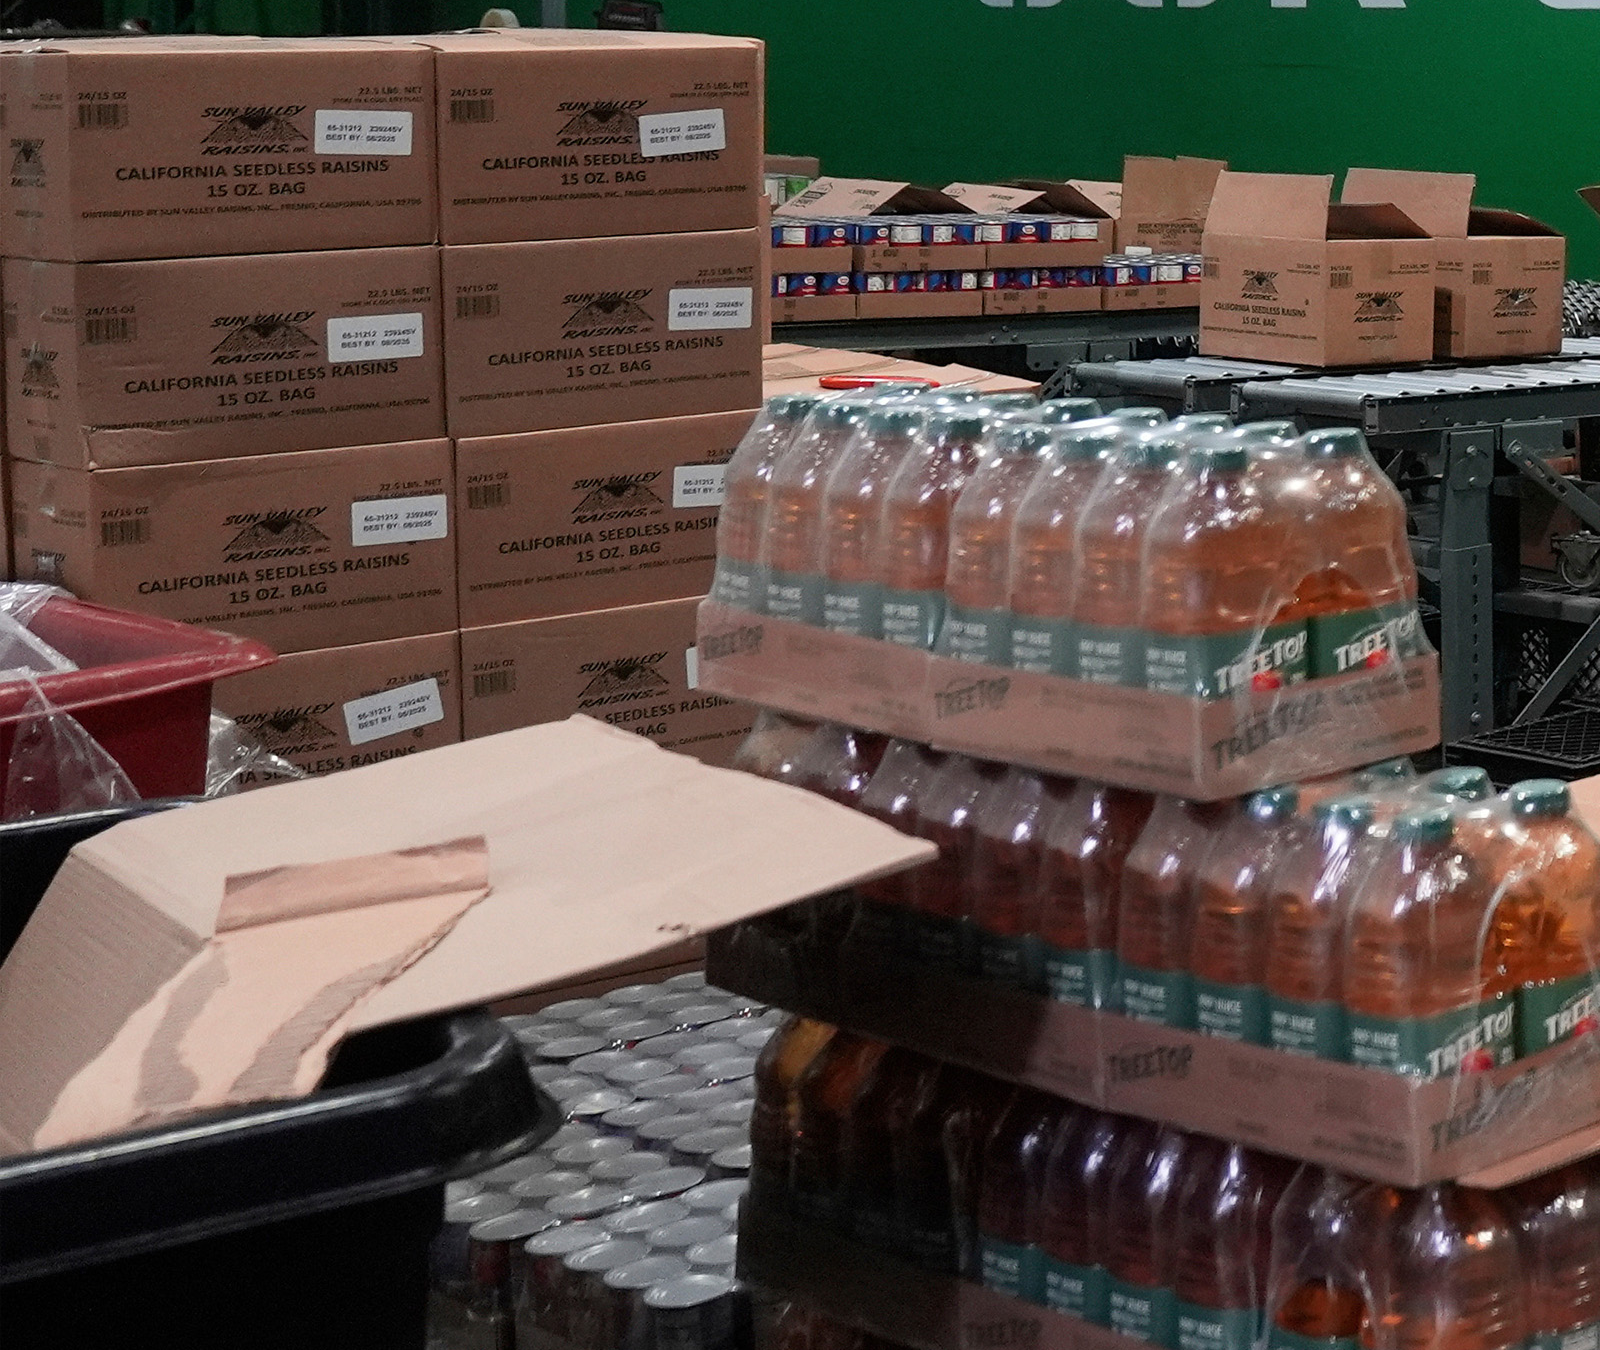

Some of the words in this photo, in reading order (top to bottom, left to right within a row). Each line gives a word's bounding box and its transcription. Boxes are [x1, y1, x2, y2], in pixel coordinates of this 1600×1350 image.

[201, 106, 239, 118] SUN
[243, 105, 307, 118] VALLEY
[555, 101, 590, 112] SUN
[593, 99, 649, 111] VALLEY
[325, 133, 348, 142] BEST
[650, 135, 669, 144] BEST
[115, 164, 228, 181] CALIFORNIA
[233, 162, 317, 178] SEEDLESS
[321, 159, 390, 174] RAISINS
[482, 154, 579, 171] CALIFORNIA
[583, 151, 656, 167] SEEDLESS
[560, 173, 579, 186] 15
[583, 171, 609, 185] OZ.
[615, 170, 647, 183] BAG
[207, 184, 228, 198] 15
[233, 182, 262, 197] OZ.
[269, 182, 306, 196] BAG
[560, 292, 596, 305] SUN
[599, 288, 653, 301] VALLEY
[1212, 301, 1250, 314] CALIFORNIA
[1251, 305, 1281, 316] SEEDLESS
[1281, 306, 1307, 318] RAISINS
[210, 315, 250, 328] SUN
[254, 311, 316, 324] VALLEY
[1242, 316, 1250, 326] 15
[1262, 317, 1277, 328] BAG
[340, 340, 363, 349] BEST
[488, 347, 585, 367] CALIFORNIA
[588, 340, 660, 358] SEEDLESS
[665, 335, 724, 352] RAISINS
[124, 373, 238, 394] CALIFORNIA
[243, 366, 327, 385] SEEDLESS
[331, 360, 399, 378] RAISINS
[566, 365, 585, 379] 15
[589, 362, 615, 377] OZ.
[619, 359, 652, 373] BAG
[217, 393, 239, 407] 15
[243, 390, 274, 405] OZ.
[279, 386, 316, 402] BAG
[571, 477, 605, 490] SUN
[608, 470, 663, 484] VALLEY
[682, 487, 702, 495] BEST
[221, 513, 261, 527] SUN
[265, 506, 328, 520] VALLEY
[362, 523, 385, 533] BEST
[499, 531, 594, 555] CALIFORNIA
[599, 522, 670, 543] SEEDLESS
[576, 551, 595, 564] 15
[599, 546, 625, 561] OZ.
[629, 541, 661, 556] BAG
[138, 570, 250, 595] CALIFORNIA
[254, 560, 338, 583] SEEDLESS
[343, 552, 411, 573] RAISINS
[228, 590, 250, 605] 15
[255, 587, 285, 602] OZ.
[290, 581, 327, 598] BAG
[577, 662, 608, 675] SUN
[613, 651, 669, 668] VALLEY
[233, 712, 268, 726] SUN
[272, 702, 335, 720] VALLEY
[604, 704, 676, 725] SEEDLESS
[358, 718, 380, 731] BEST
[635, 721, 667, 737] BAG
